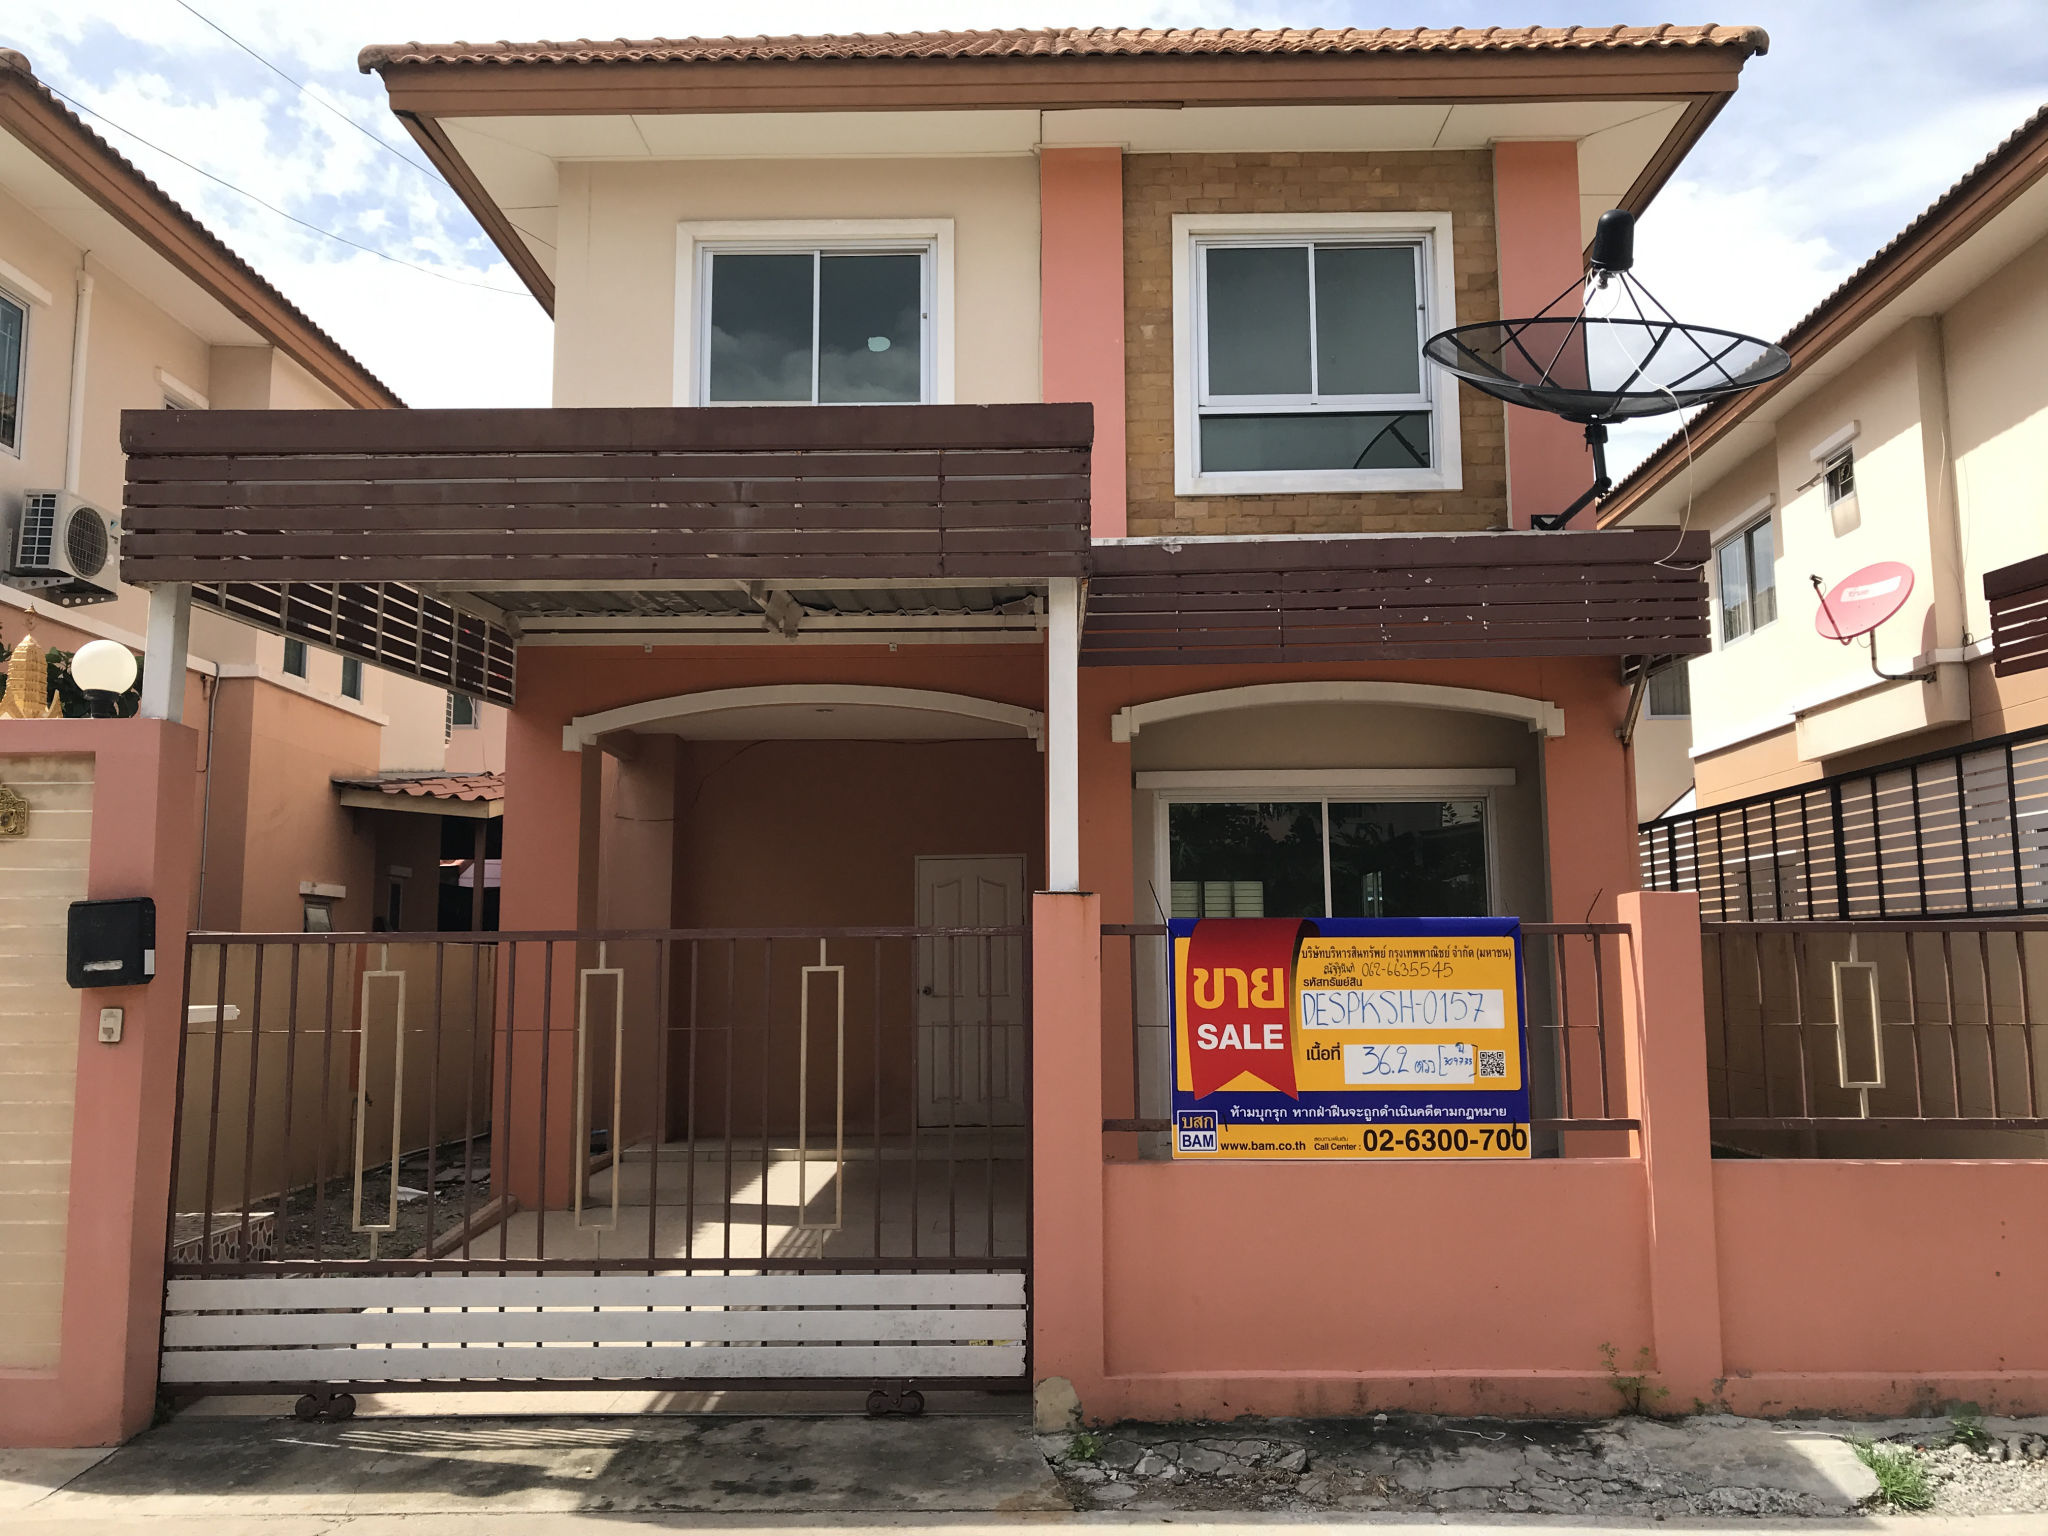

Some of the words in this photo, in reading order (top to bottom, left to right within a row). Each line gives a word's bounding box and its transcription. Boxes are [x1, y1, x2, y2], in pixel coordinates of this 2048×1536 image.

[1302, 945, 1386, 959] บริษัทบริหารสินทรัพย์
[1388, 945, 1450, 962] กรุงเทพพาณิชย์
[1452, 945, 1474, 959] จำกัด
[1476, 947, 1512, 960] (มหาชน)
[1361, 961, 1454, 979] 062-6635545
[1193, 967, 1285, 1010] ขาย
[1303, 976, 1363, 987] รหัสทรัพย์สิน
[1303, 990, 1485, 1026] DESPKSH-0157
[1197, 1023, 1284, 1050] SALE
[1306, 1042, 1341, 1062] เนื้อที่
[1362, 1045, 1409, 1075] 36.2
[1230, 1104, 1288, 1122] ห้ามบุกรุก
[1292, 1104, 1507, 1122] หากฝ่าฝืนจะถูกดำเนินคดีตามกฎหมาย
[1181, 1116, 1214, 1129] บสก
[1182, 1134, 1214, 1148] BAM
[1220, 1141, 1306, 1151] www.bam.co.th
[1314, 1142, 1329, 1151] Call
[1330, 1142, 1357, 1151] Center
[1362, 1128, 1528, 1152] 02-6300-700
